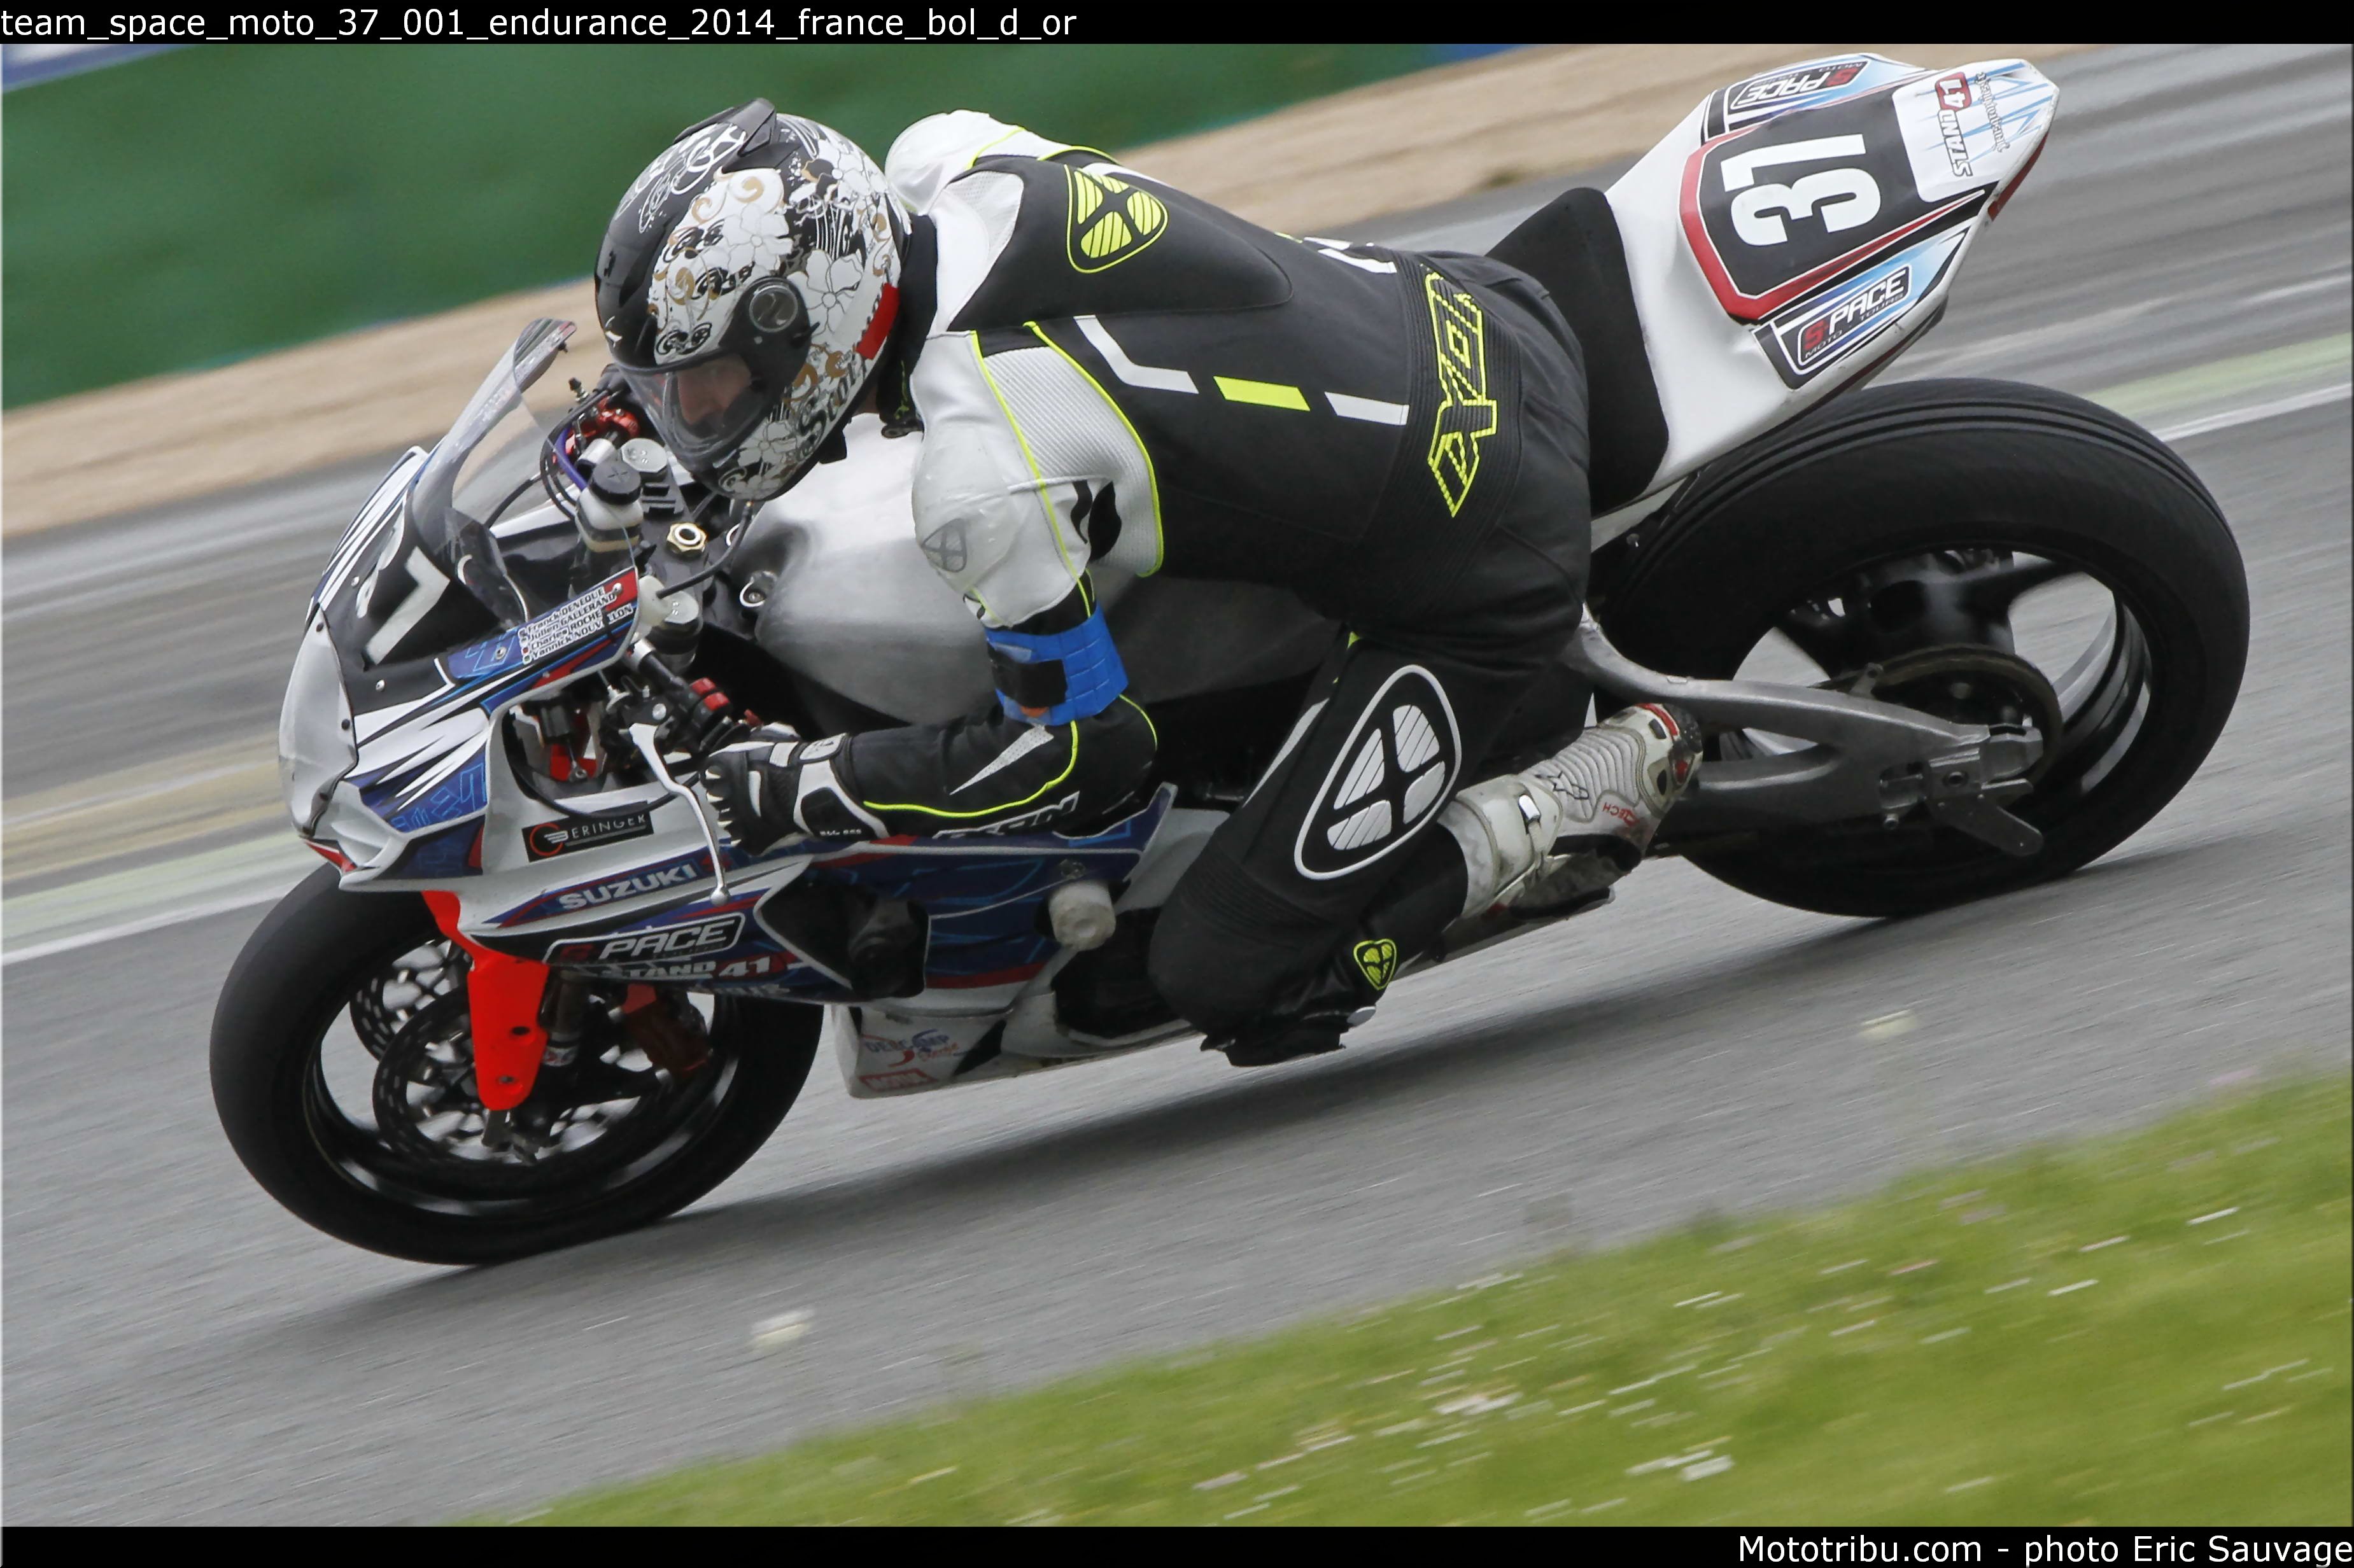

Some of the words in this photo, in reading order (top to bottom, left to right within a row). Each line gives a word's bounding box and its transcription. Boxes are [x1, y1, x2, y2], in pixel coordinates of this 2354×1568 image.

[1939, 78, 1967, 108] 41
[1937, 109, 1973, 177] STAND
[1805, 330, 1843, 359] MOTO
[528, 612, 560, 633] Franck
[560, 593, 616, 626] GALLERAND
[569, 610, 602, 630] ROCHE
[558, 863, 698, 910] SUZUKI
[719, 956, 770, 977] 41
